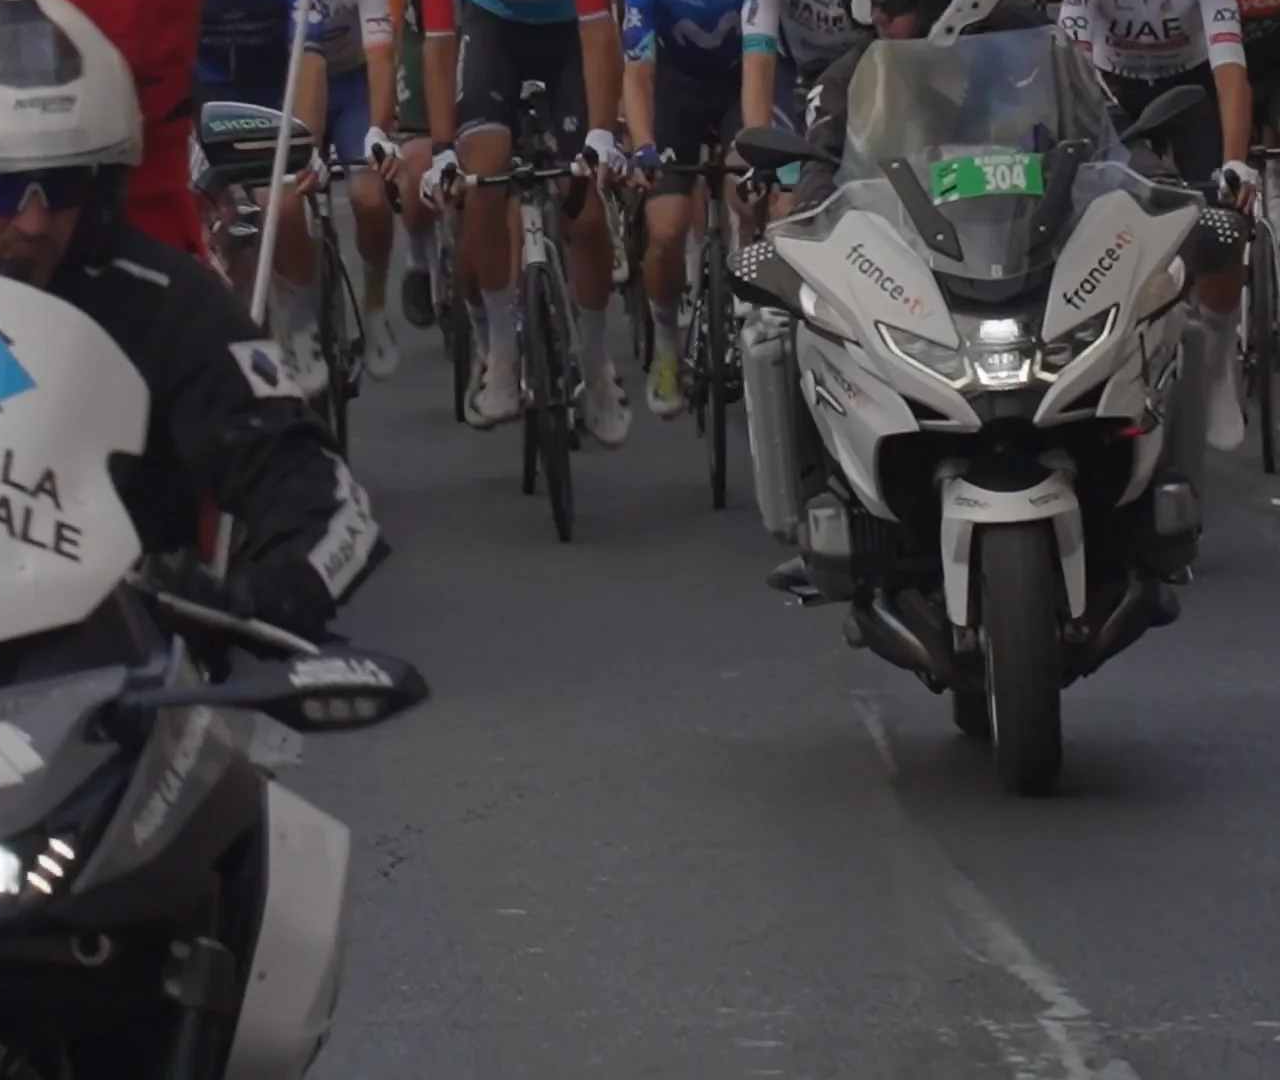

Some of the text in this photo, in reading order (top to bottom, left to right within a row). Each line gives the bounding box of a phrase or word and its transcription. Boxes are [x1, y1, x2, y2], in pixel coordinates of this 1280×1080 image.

[1109, 19, 1180, 41] UAE
[982, 164, 1028, 192] 304
[0, 448, 63, 512] LA
